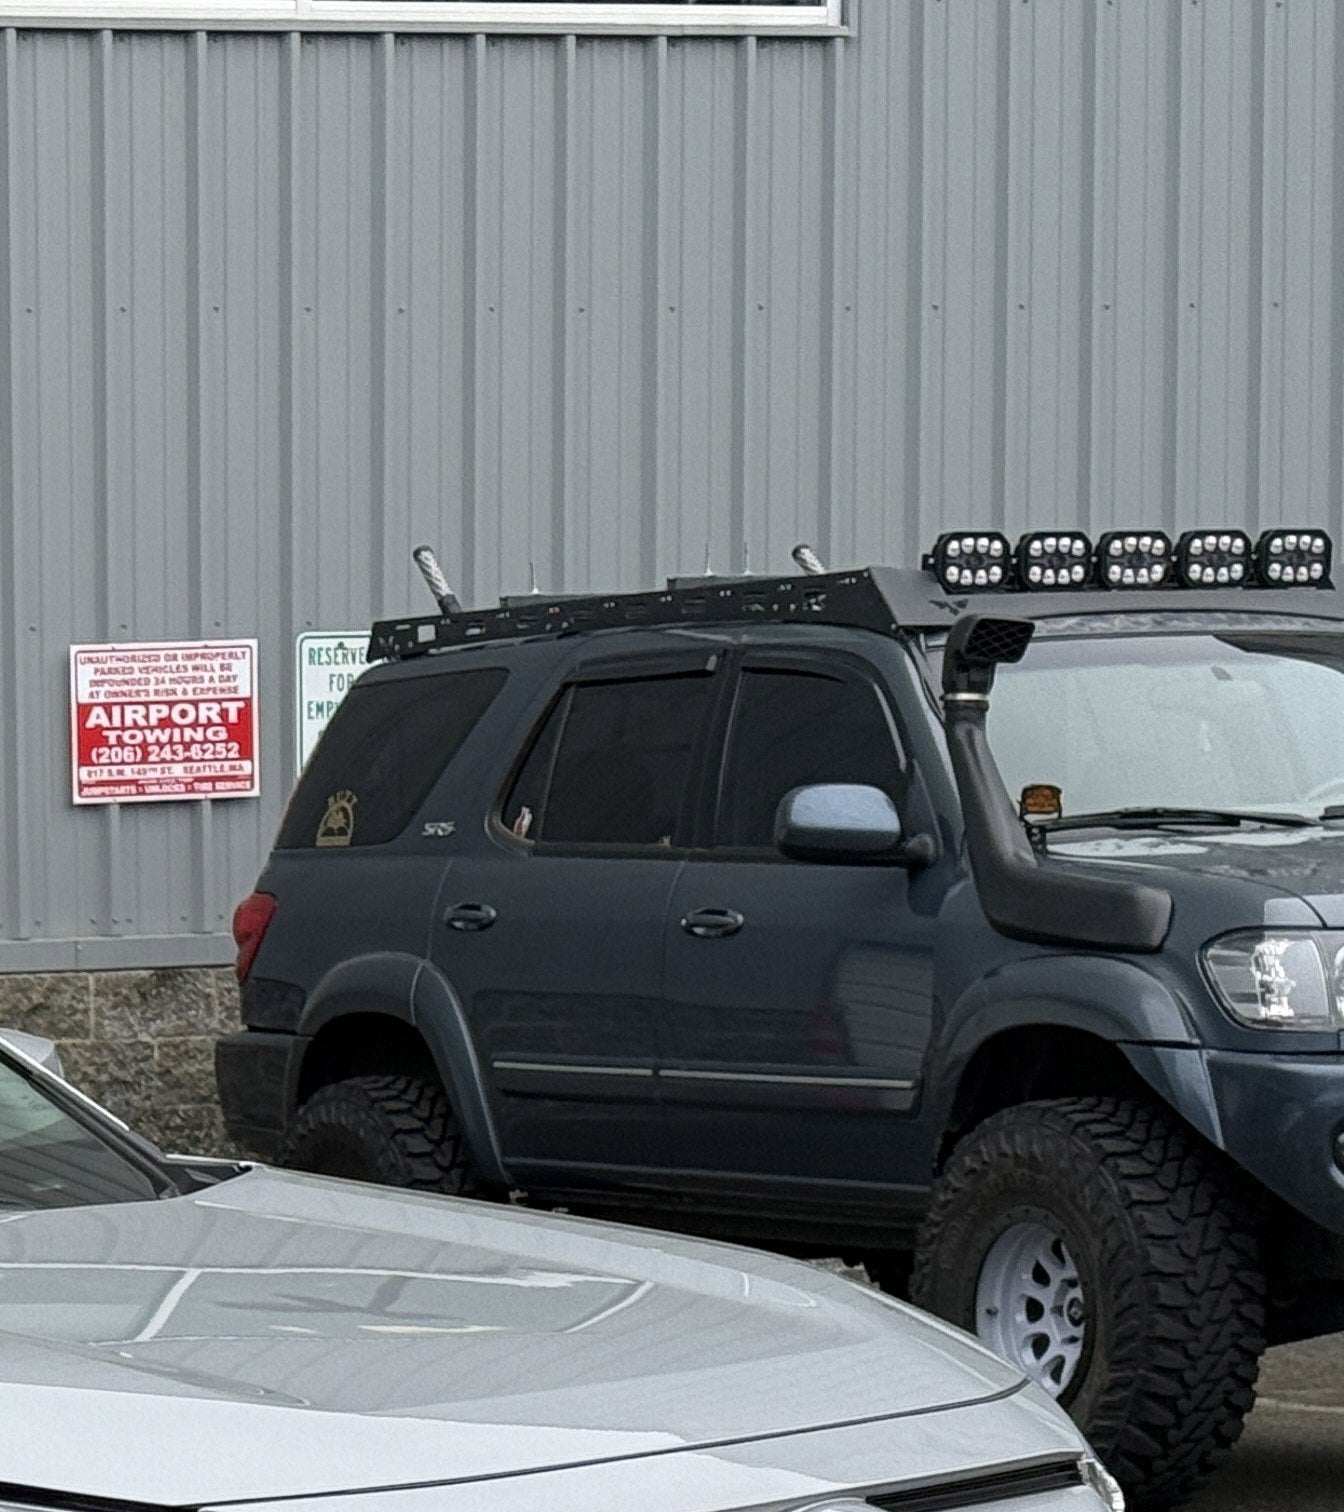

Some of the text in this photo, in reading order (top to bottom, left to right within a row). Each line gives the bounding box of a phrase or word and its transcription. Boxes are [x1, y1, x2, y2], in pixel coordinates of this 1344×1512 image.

[164, 653, 178, 662] OR
[181, 651, 246, 661] IMPROPERLY
[308, 646, 365, 666] RESERVE
[93, 666, 135, 676] PARKED
[138, 664, 188, 674] VEHICLES
[191, 663, 216, 673] WILL
[192, 685, 239, 696] EXPENSE
[85, 701, 246, 729] AIRPORT
[102, 726, 228, 745] TOWING
[91, 742, 240, 764] (206) 243-6252
